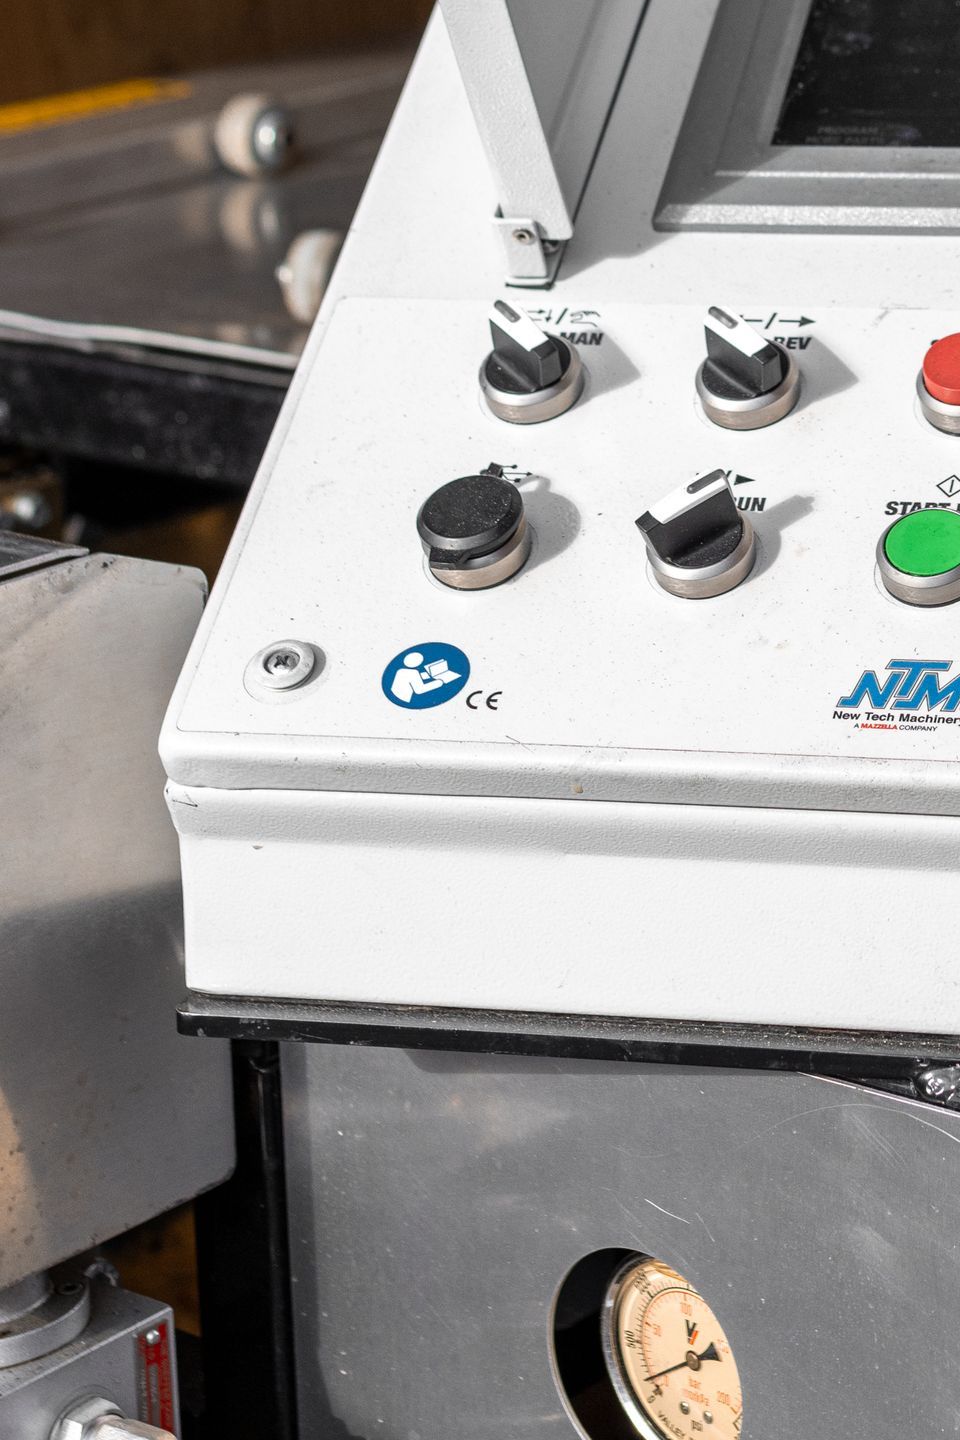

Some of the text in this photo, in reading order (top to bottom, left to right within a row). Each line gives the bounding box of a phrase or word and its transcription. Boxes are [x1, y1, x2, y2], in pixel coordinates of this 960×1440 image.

[733, 496, 767, 512] UN
[832, 710, 862, 721] New
[864, 711, 895, 723] Tech
[860, 722, 898, 730] MAZZELLA
[898, 724, 938, 732] COMPANY
